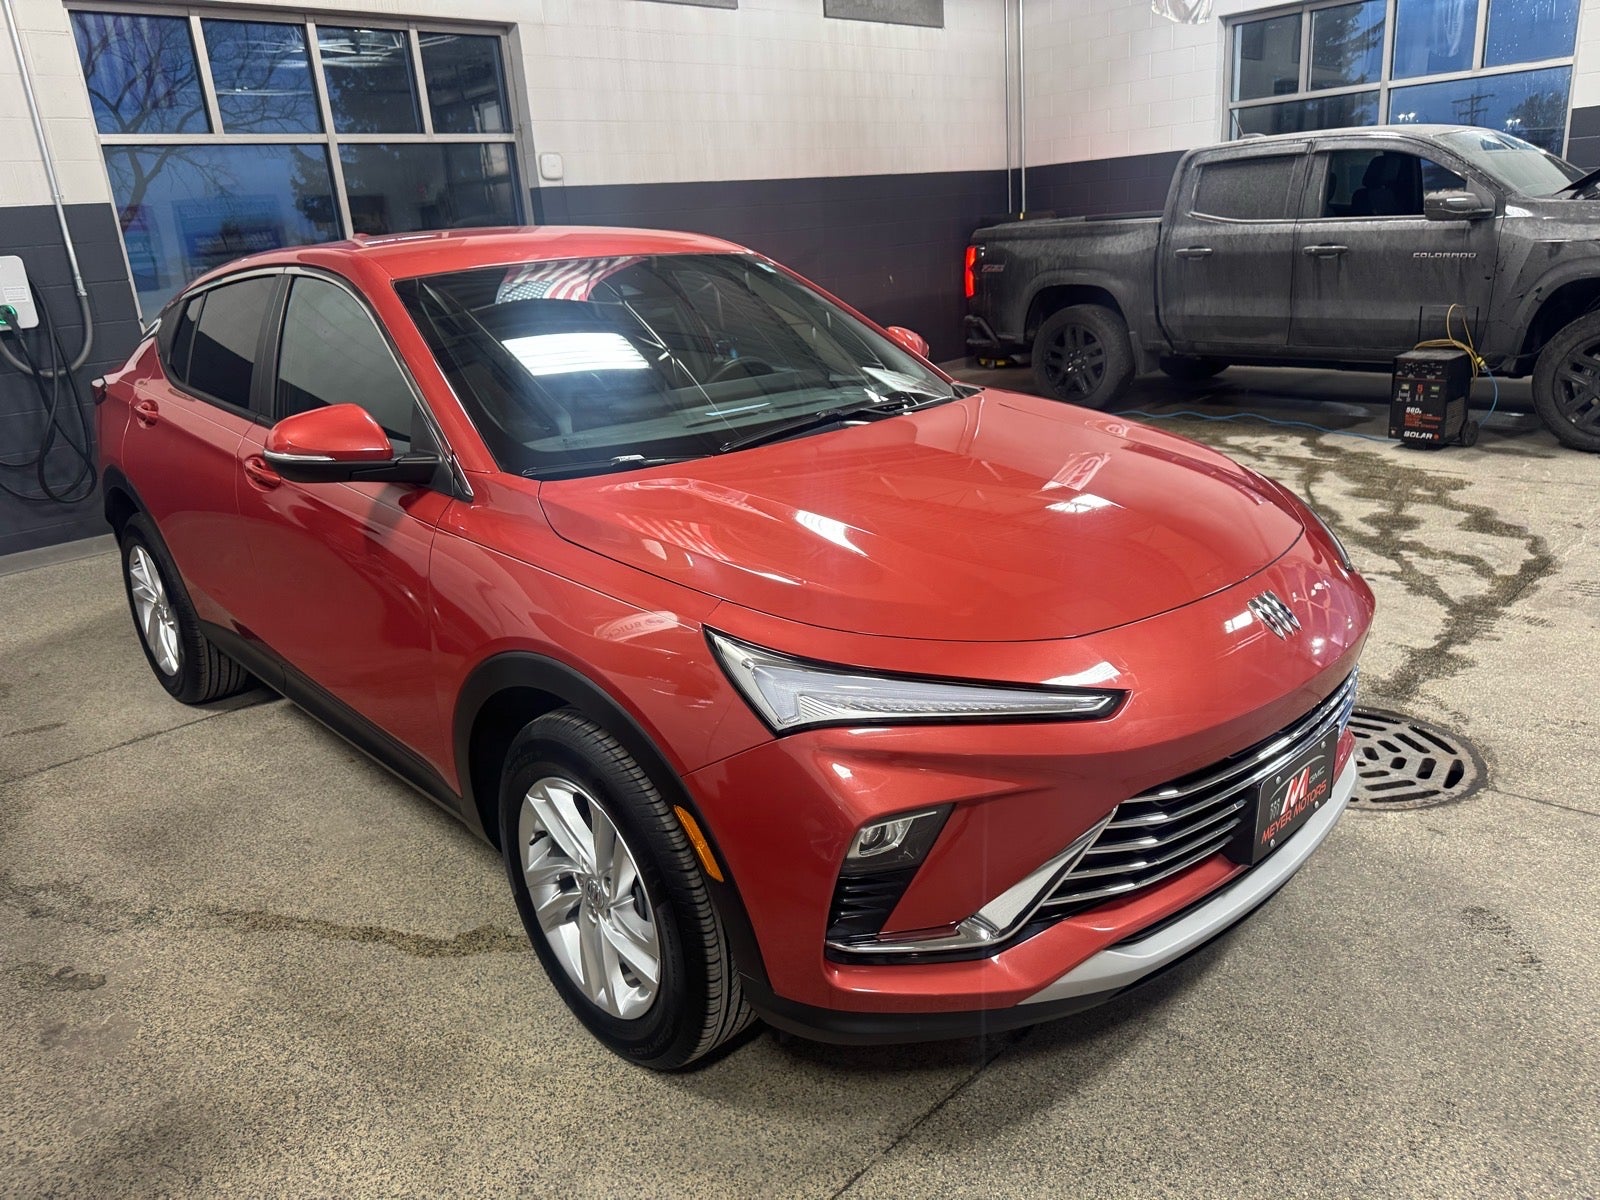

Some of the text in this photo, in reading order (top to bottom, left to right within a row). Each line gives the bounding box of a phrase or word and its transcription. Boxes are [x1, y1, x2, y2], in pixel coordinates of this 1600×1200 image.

[1309, 766, 1325, 784] GMC
[1261, 779, 1327, 844] MEYER MOTORS
